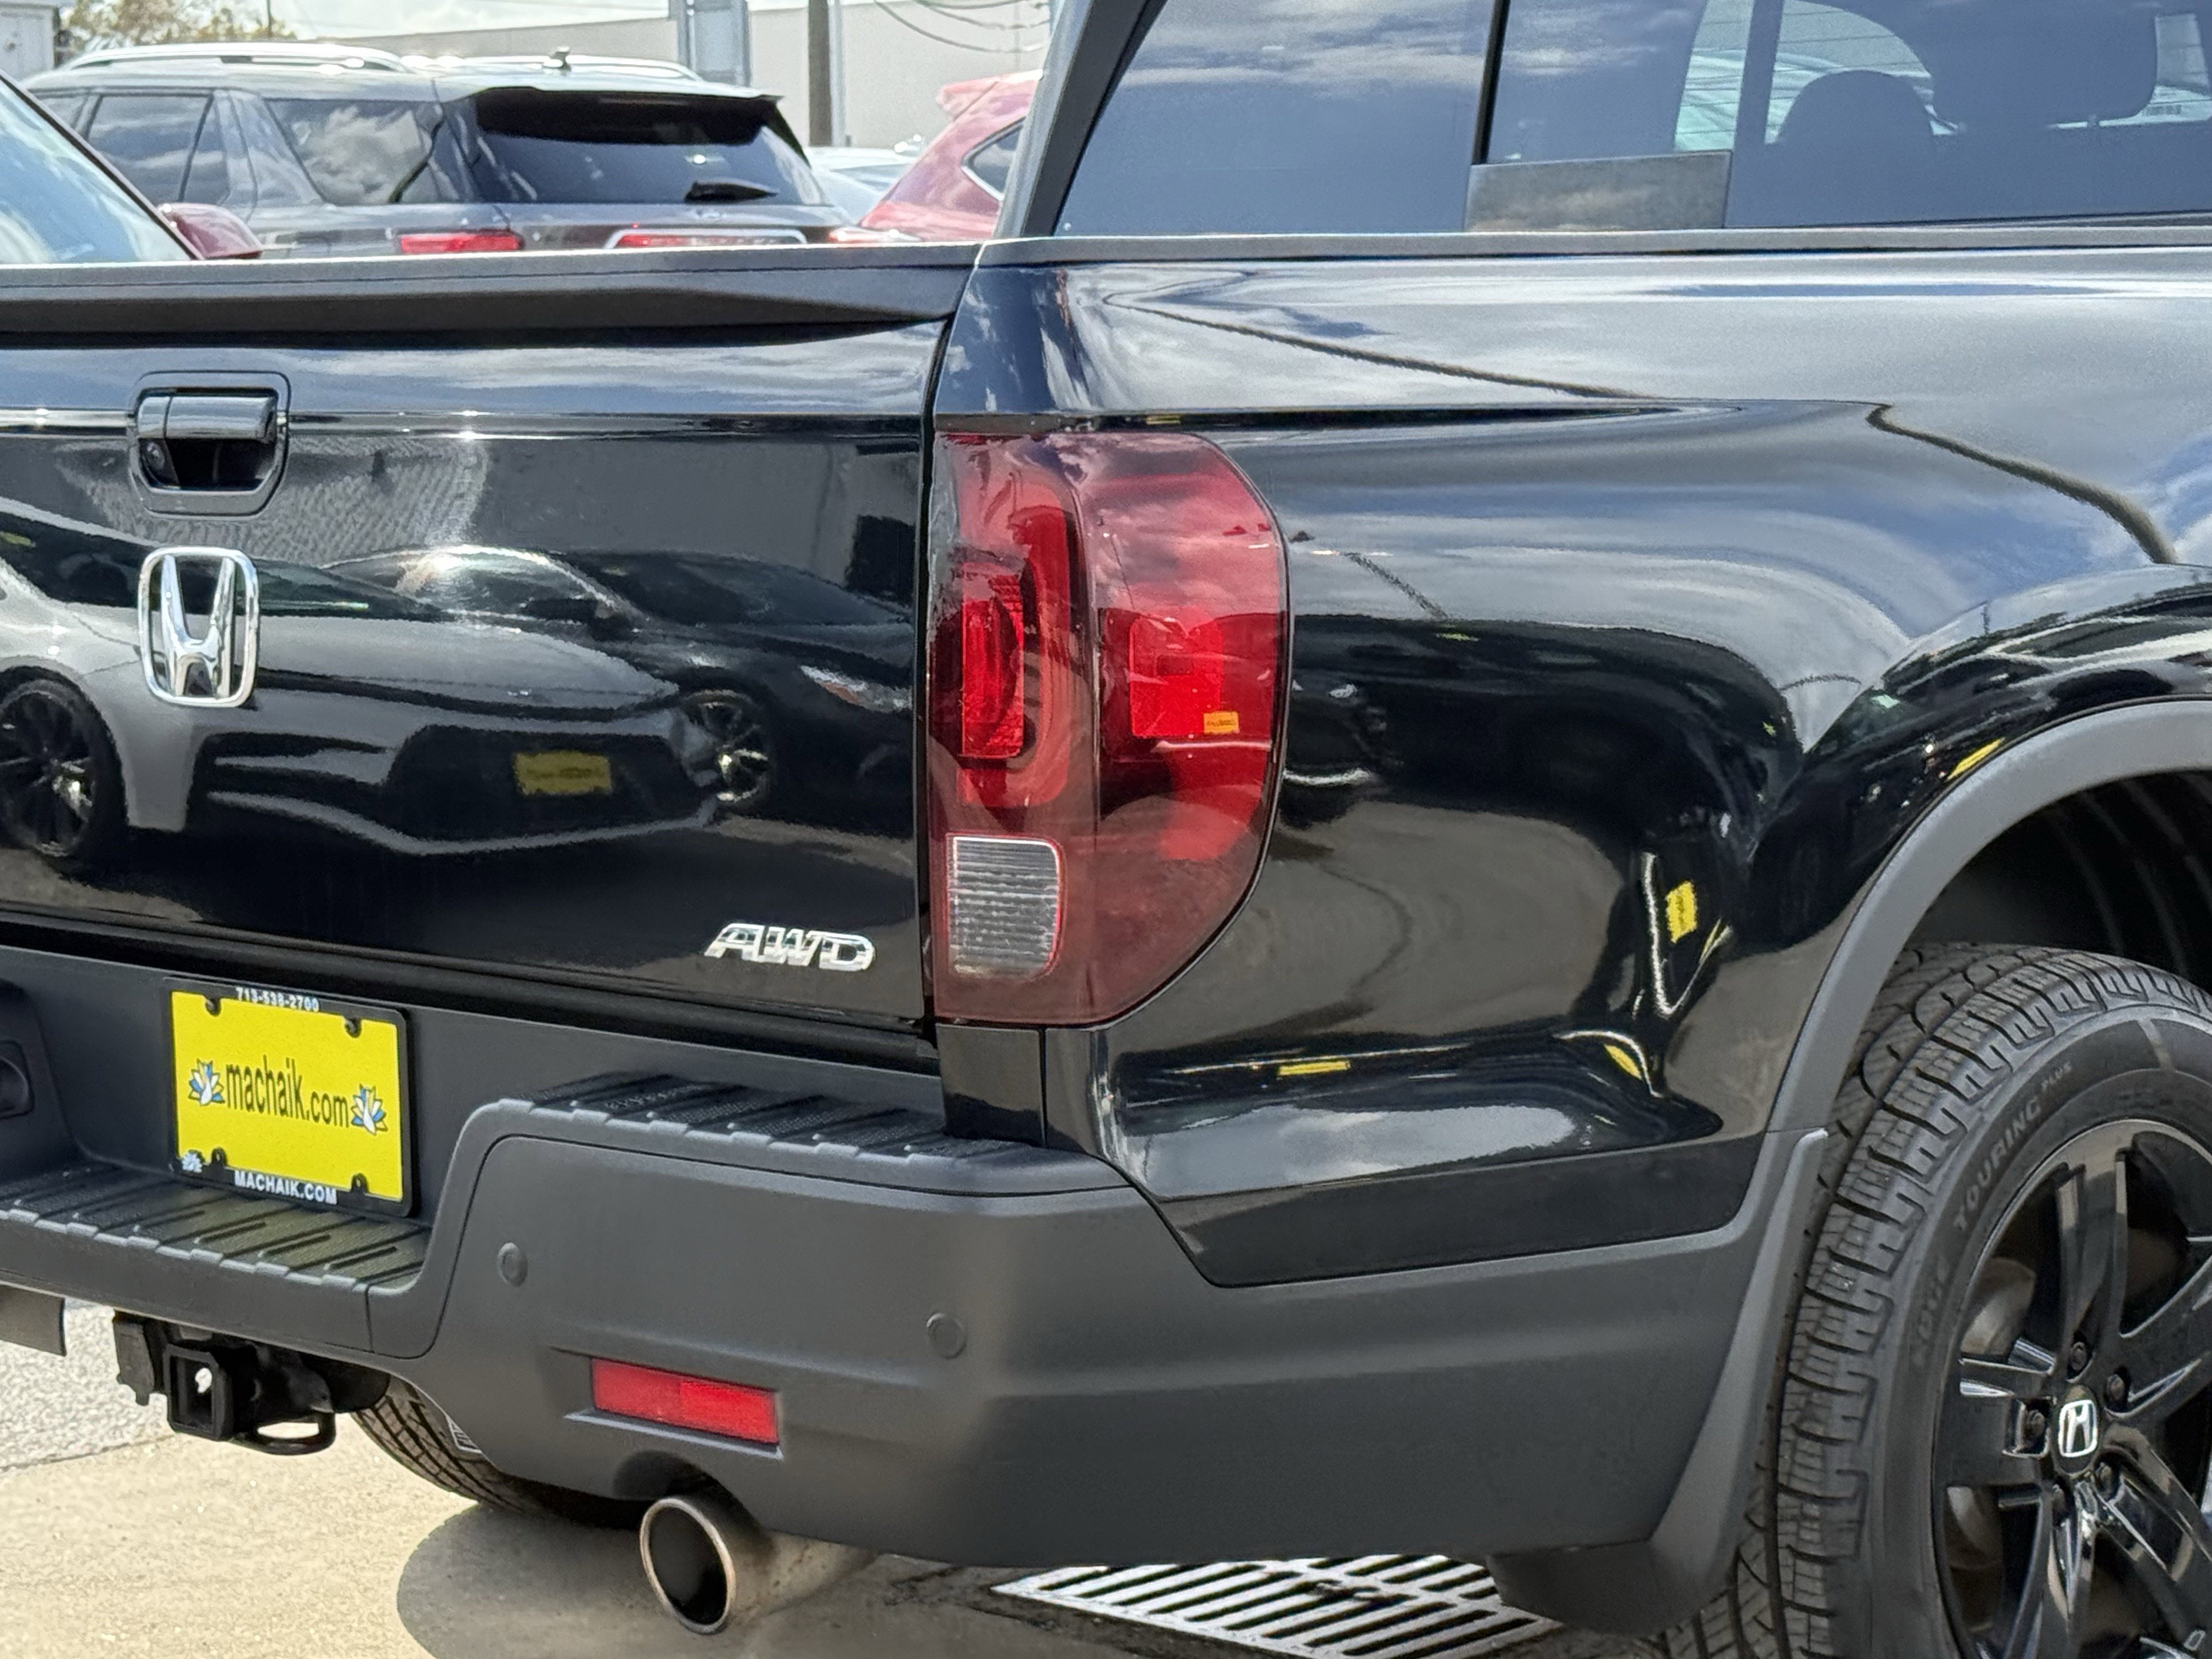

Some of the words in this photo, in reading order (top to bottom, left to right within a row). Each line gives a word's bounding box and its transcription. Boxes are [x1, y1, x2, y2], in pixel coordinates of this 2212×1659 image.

[704, 923, 877, 972] AWD
[225, 1054, 349, 1127] machaik.com
[233, 1170, 337, 1205] MACHAIK.COM
[1953, 1095, 2042, 1231] TOURING
